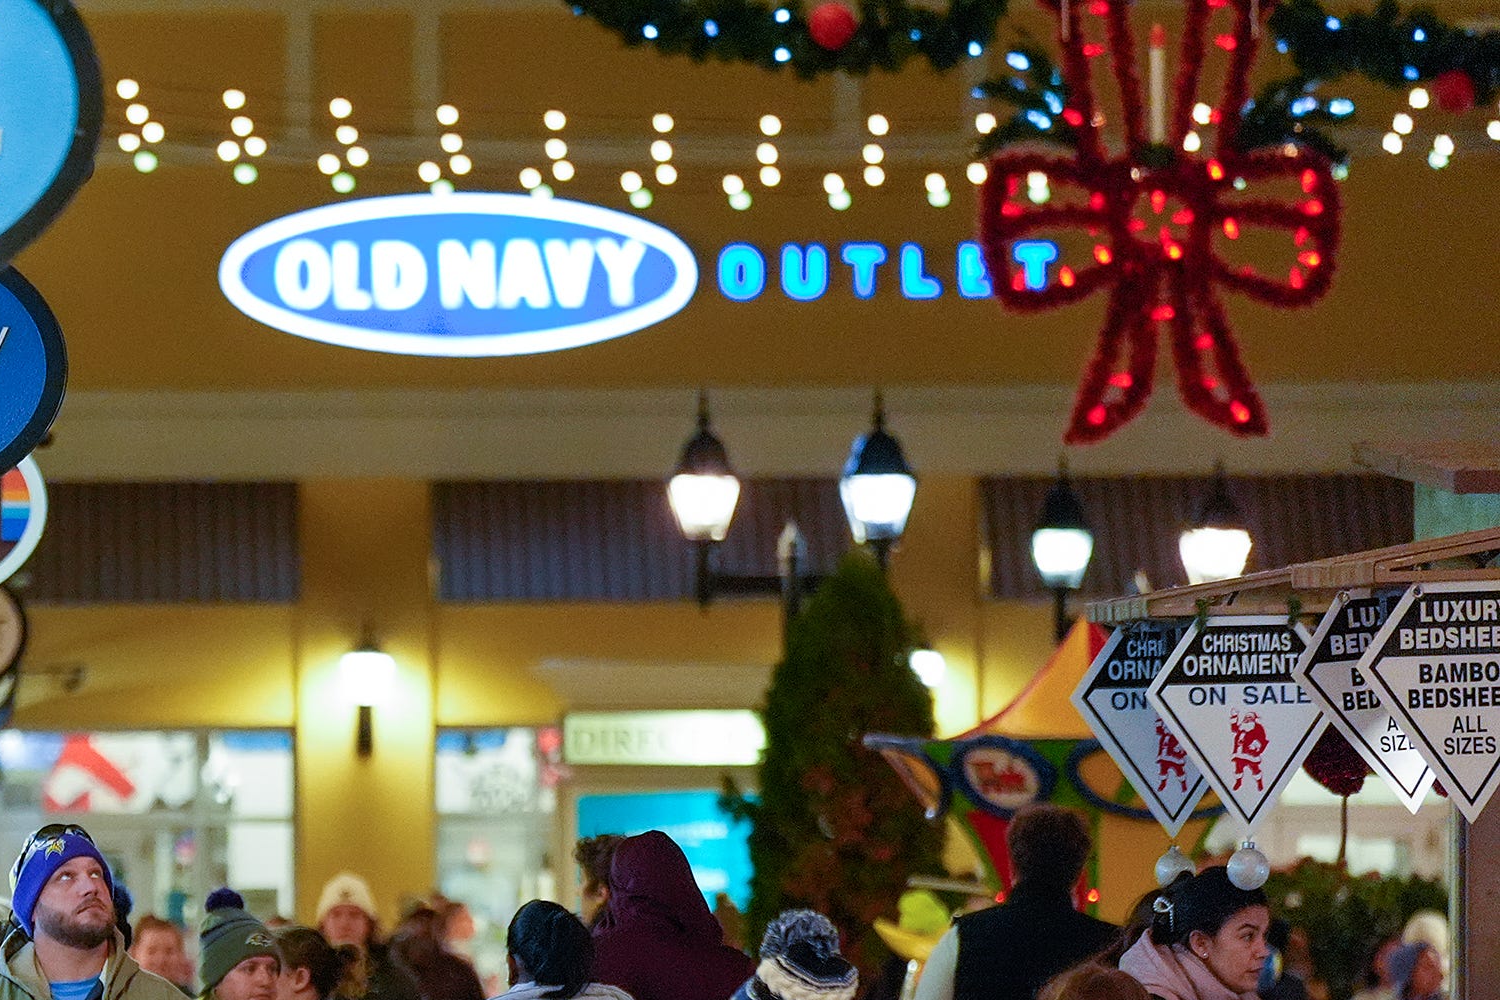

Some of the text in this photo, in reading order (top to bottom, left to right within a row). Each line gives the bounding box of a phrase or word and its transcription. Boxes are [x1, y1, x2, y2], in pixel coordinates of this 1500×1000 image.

[274, 236, 648, 311] OLD NAVY
[1419, 599, 1500, 623] LUXUR
[1202, 632, 1292, 653] CHRISTMAS
[1182, 652, 1302, 677] ORNAMENT
[1188, 685, 1312, 706] ON SALE
[1452, 715, 1488, 733] ALL
[1443, 735, 1497, 756] SIZES
